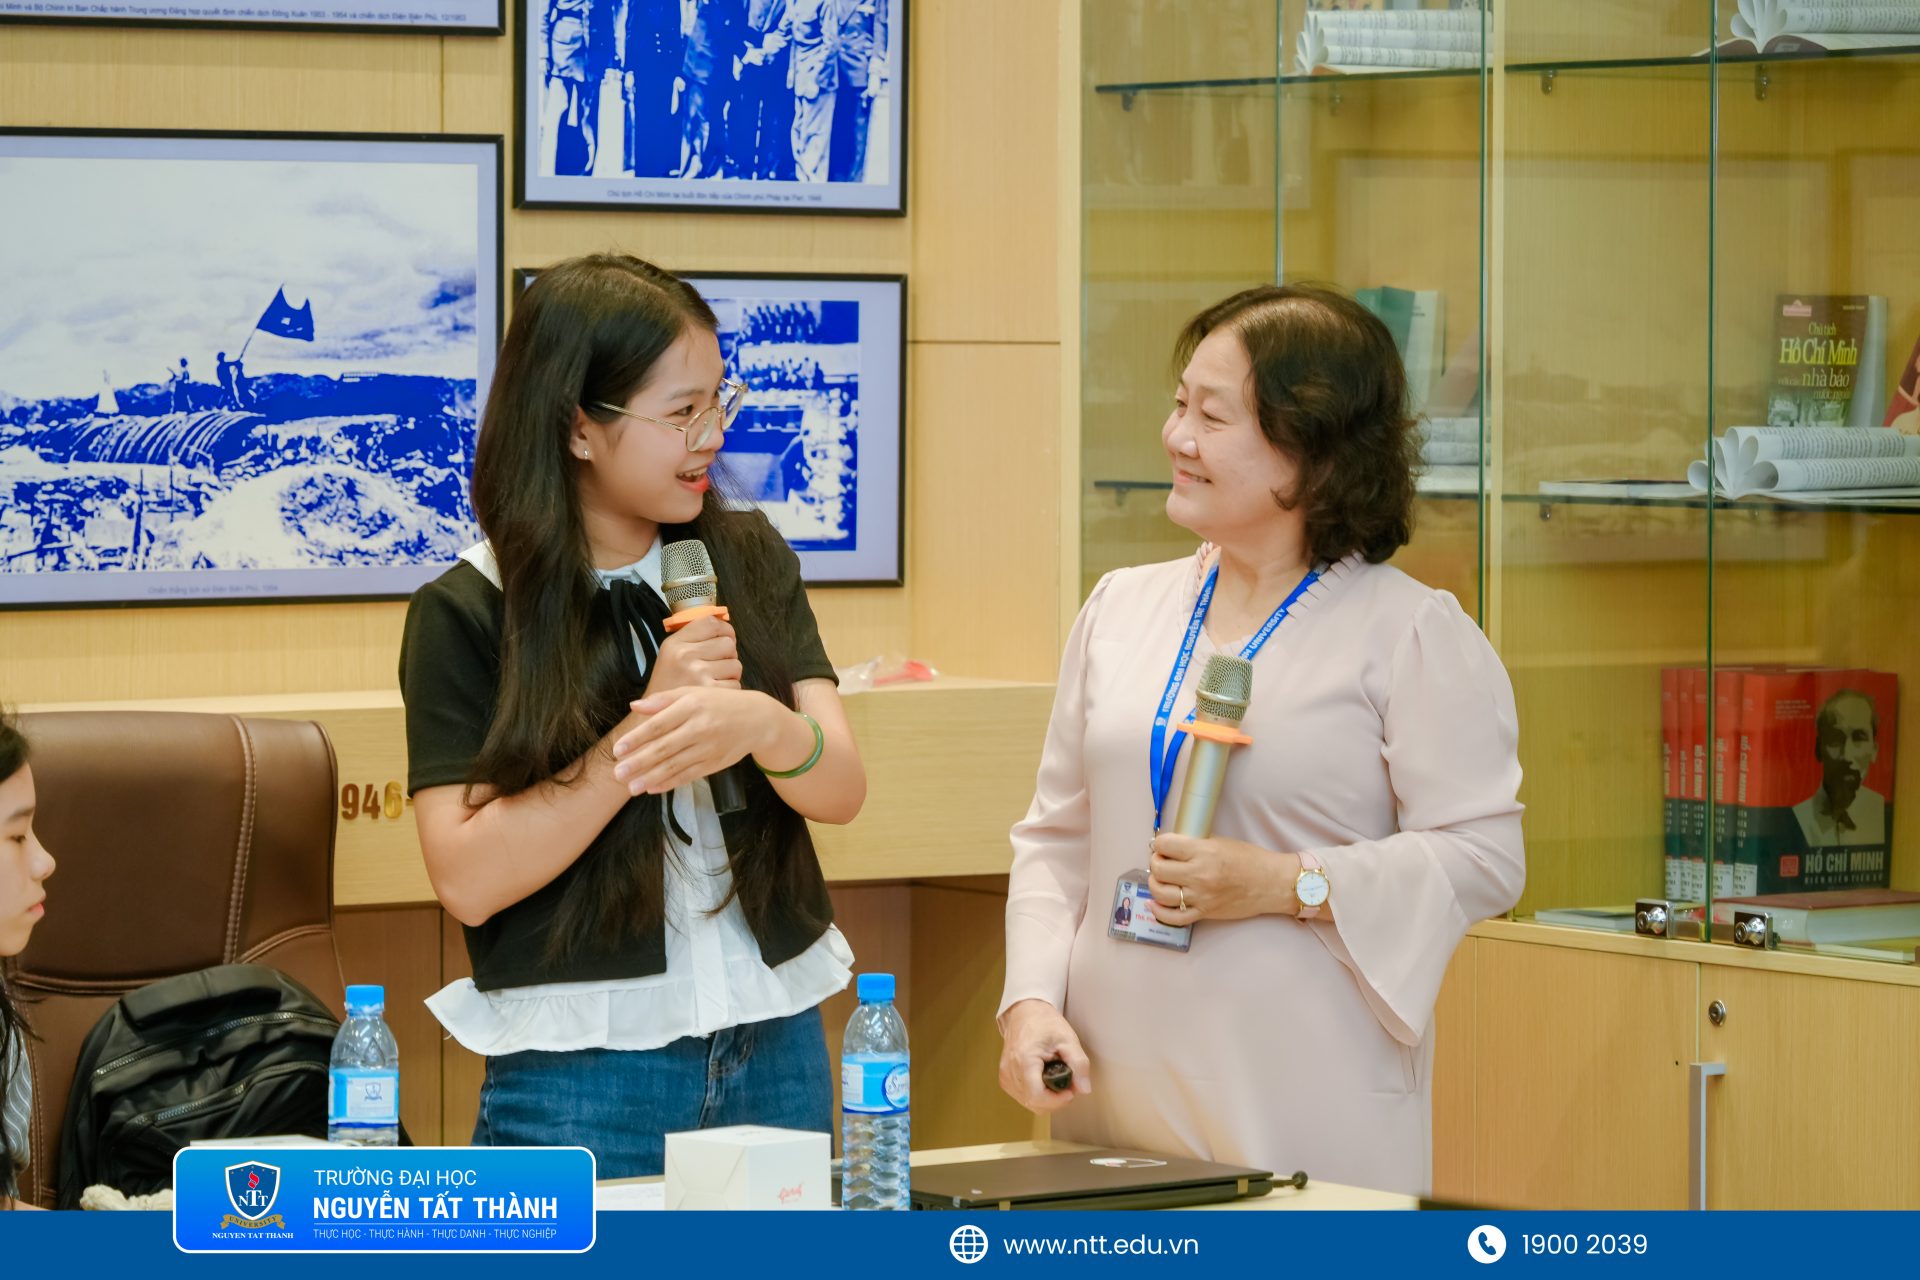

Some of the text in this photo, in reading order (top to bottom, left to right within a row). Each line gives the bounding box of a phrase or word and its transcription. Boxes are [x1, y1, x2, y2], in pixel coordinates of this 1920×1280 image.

[1779, 337, 1857, 365] Hồ Chí Minh
[1802, 368, 1827, 387] nhà
[1829, 368, 1850, 387] báo
[1248, 608, 1286, 650] UNIVERSITY
[1826, 849, 1848, 873] CHÍ
[1850, 851, 1884, 872] MINH
